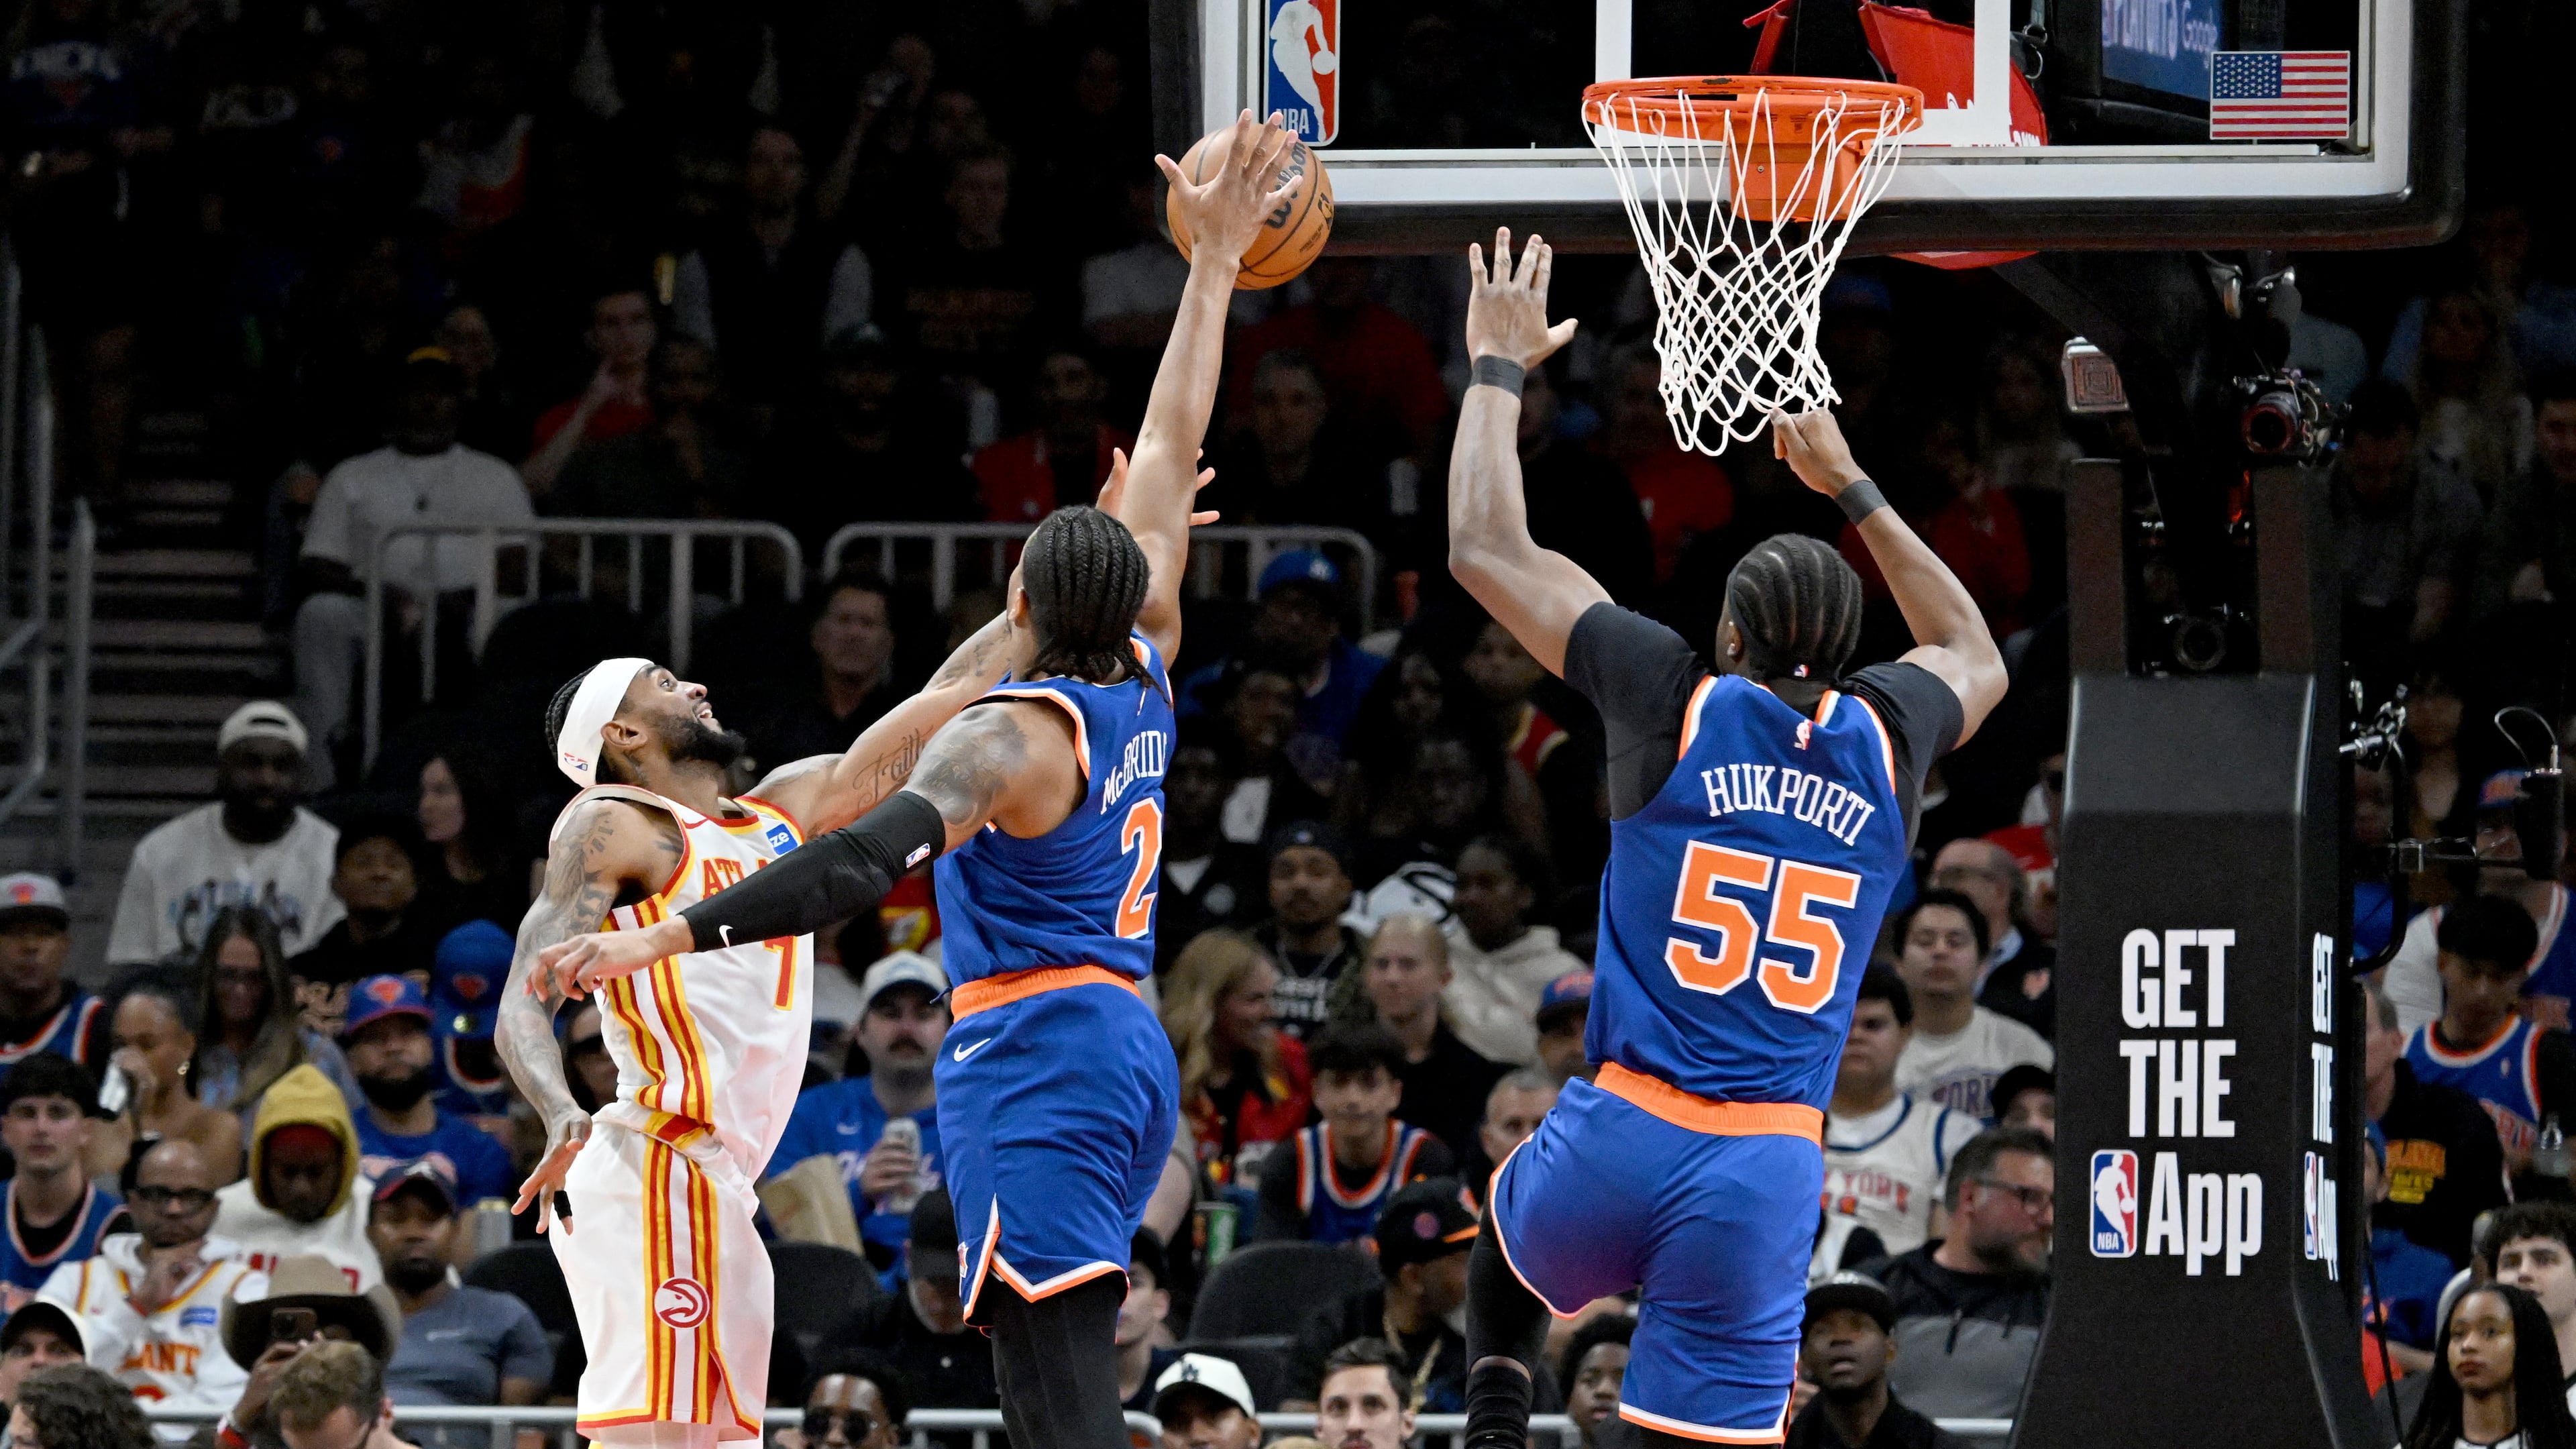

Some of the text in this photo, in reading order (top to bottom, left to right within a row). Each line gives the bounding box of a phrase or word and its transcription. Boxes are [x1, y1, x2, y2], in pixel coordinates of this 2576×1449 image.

[1276, 109, 1310, 134] NBA
[1100, 731, 1167, 815] McBRID
[1701, 763, 1875, 847] HUKPORTI
[1114, 796, 1163, 939] 2
[763, 935, 798, 1012] 7
[1664, 839, 1862, 1015] 55
[2121, 928, 2237, 1029] GET
[2312, 932, 2334, 1034] GET
[2119, 1038, 2237, 1138] THE
[2311, 1041, 2334, 1144] THE
[2097, 1150, 2263, 1277] NBA App
[2317, 1155, 2340, 1282] App
